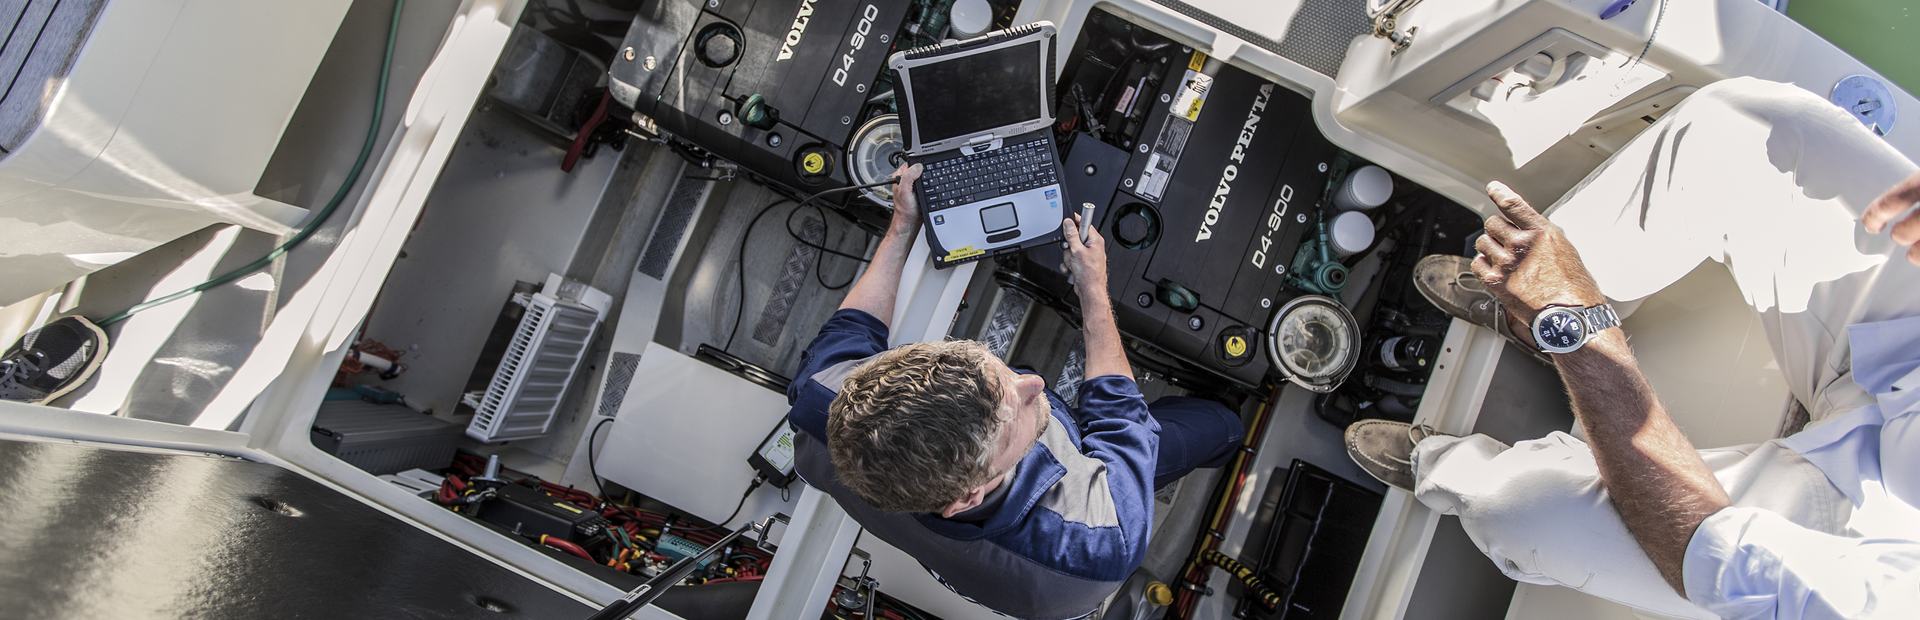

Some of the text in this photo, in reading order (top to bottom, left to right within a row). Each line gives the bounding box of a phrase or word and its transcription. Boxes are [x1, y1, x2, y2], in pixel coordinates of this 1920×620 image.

[776, 0, 818, 62] VOLV
[832, 3, 879, 87] D4-300
[1195, 82, 1276, 243] VOLVO PENTA
[1251, 184, 1294, 269] D4-300
[1543, 329, 1551, 338] 12
